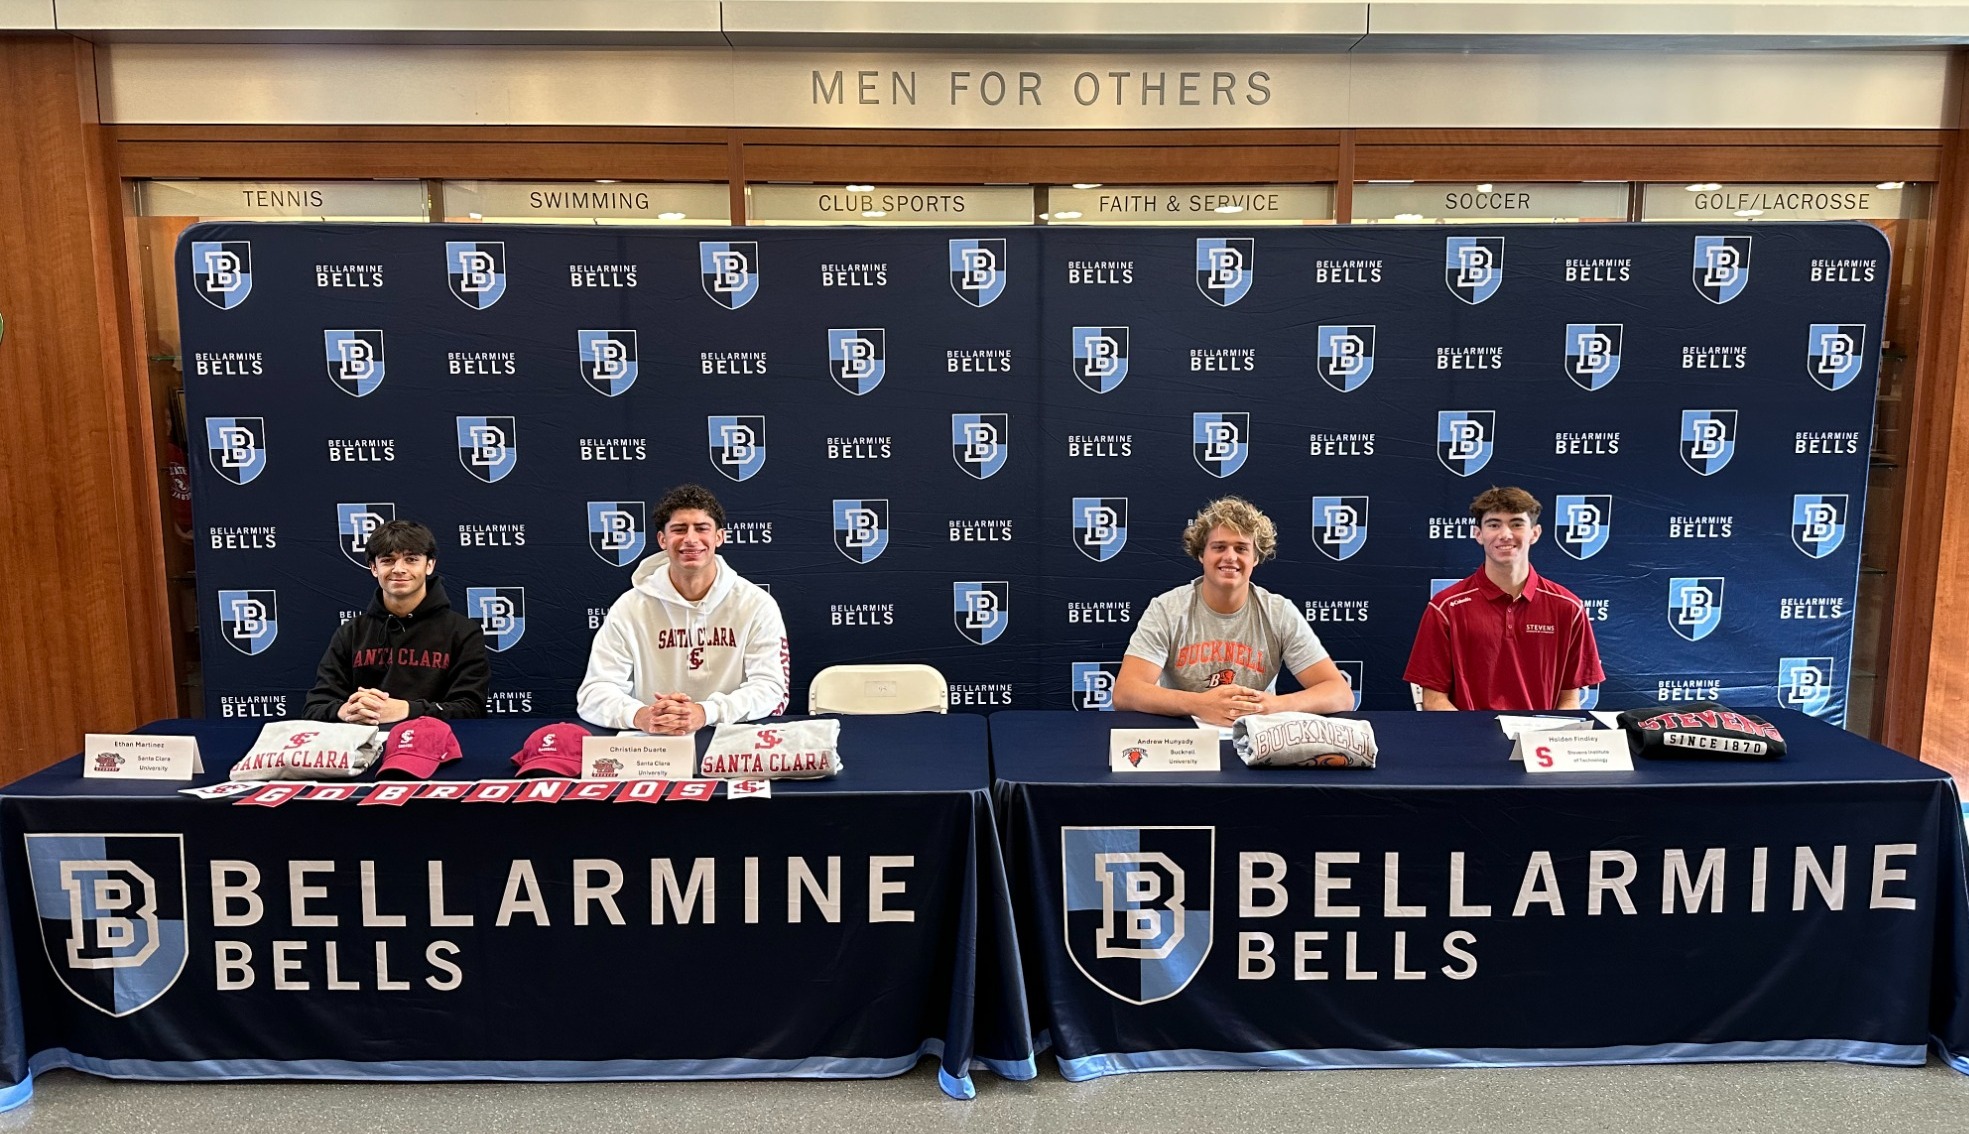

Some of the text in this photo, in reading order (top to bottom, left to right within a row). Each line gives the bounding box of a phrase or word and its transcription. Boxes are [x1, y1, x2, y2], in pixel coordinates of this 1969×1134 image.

[813, 70, 1271, 106] MEN FOR OTHERS
[242, 190, 323, 208] TENNIS
[530, 191, 649, 210] SWIMMING
[818, 194, 965, 213] CLUB SPORTS
[1099, 194, 1279, 213] FAITH & SERVICE
[1445, 192, 1530, 210] SOCCER
[1694, 193, 1870, 211] GOLF/LACROSSE
[315, 264, 383, 273] BELLARMINE
[569, 264, 637, 273] BELLARMINE
[821, 263, 888, 272] BELLARMINE
[961, 248, 996, 290] B
[1068, 261, 1134, 270] BELLARMINE
[1207, 247, 1243, 290] B
[1316, 260, 1383, 269] BELLARMINE
[1457, 245, 1493, 288] B
[1565, 258, 1631, 267] BELLARMINE
[1703, 245, 1740, 287] B
[1811, 259, 1877, 268] BELLARMINE
[204, 251, 242, 292] B
[458, 250, 496, 294] B
[712, 250, 749, 293] B
[1069, 270, 1133, 284] BELLS
[1316, 268, 1382, 283] BELLS
[1565, 267, 1630, 282] BELLS
[1810, 268, 1875, 282] BELLS
[316, 273, 384, 288] BELLS
[570, 273, 638, 288] BELLS
[822, 272, 887, 287] BELLS
[195, 352, 263, 361] BELLARMINE
[448, 352, 515, 361] BELLARMINE
[700, 352, 767, 360] BELLARMINE
[946, 349, 1012, 358] BELLARMINE
[1190, 348, 1255, 357] BELLARMINE
[1437, 346, 1503, 355] BELLARMINE
[1682, 346, 1747, 355] BELLARMINE
[1818, 333, 1854, 374] B
[840, 337, 876, 379] B
[1190, 357, 1255, 371] BELLS
[1437, 355, 1502, 370] BELLS
[1682, 355, 1746, 369] BELLS
[196, 361, 263, 376] BELLS
[449, 361, 516, 375] BELLS
[701, 360, 767, 375] BELLS
[947, 358, 1011, 373] BELLS
[579, 438, 647, 447] BELLARMINE
[827, 436, 892, 445] BELLARMINE
[1068, 435, 1133, 443] BELLARMINE
[1204, 421, 1239, 462] B
[1310, 433, 1375, 442] BELLARMINE
[1555, 432, 1620, 441] BELLARMINE
[1795, 431, 1859, 440] BELLARMINE
[218, 426, 256, 468] B
[328, 439, 395, 448] BELLARMINE
[1069, 443, 1132, 457] BELLS
[1310, 442, 1374, 456] BELLS
[1555, 440, 1619, 455] BELLS
[1795, 440, 1857, 454] BELLS
[329, 447, 395, 462] BELLS
[580, 447, 647, 461] BELLS
[827, 445, 891, 459] BELLS
[725, 522, 772, 530] LLARMINE
[949, 519, 1012, 528] BELLARMINE
[1084, 506, 1118, 546] B
[1429, 517, 1476, 525] BELLARM
[1565, 503, 1601, 544] B
[1670, 516, 1733, 524] BELLARMINE
[210, 526, 276, 535] BELLARMINE
[458, 524, 525, 532] BELLARMINE
[599, 510, 636, 550] B
[949, 528, 1012, 542] BELLS
[1429, 525, 1477, 539] BELL
[1669, 524, 1732, 538] BELLS
[211, 535, 277, 549] BELLS
[460, 532, 526, 547] BELLS
[724, 530, 772, 544] ELLS
[830, 604, 894, 612] BELLARMINE
[1068, 601, 1131, 610] BELLARMINE
[1304, 600, 1369, 608] BELLARMINE
[1678, 586, 1713, 625] B
[1780, 597, 1844, 606] BELLARMINE
[965, 590, 999, 629] B
[1068, 609, 1130, 623] BELLS
[1306, 609, 1368, 622] BELLS
[1779, 606, 1842, 620] BELLS
[231, 599, 268, 639] B
[831, 612, 894, 626] BELLS
[658, 628, 693, 649] SATA
[353, 648, 393, 668] ANTA
[1174, 639, 1266, 674] BUCKNELL
[950, 684, 1013, 692] BELLARMINE
[1658, 679, 1721, 688] BELLARMINE
[1787, 665, 1824, 704] B
[221, 695, 287, 704] BELLARMINE
[950, 692, 1012, 705] BELLS
[1657, 688, 1720, 701] BELLS
[222, 703, 287, 718] BELLS
[486, 699, 533, 713] ELLS
[135, 741, 165, 749] Martinez
[1255, 719, 1375, 764] BUCKNELL
[1669, 734, 1762, 754] SINCE 1870
[291, 750, 349, 769] CLARA
[702, 751, 831, 774] SANTA CLARA
[1535, 746, 1554, 768] S
[374, 781, 705, 800] BRONCOS
[1238, 843, 1917, 918] BELLARMINE
[209, 855, 915, 927] BELLARMINE
[1095, 852, 1187, 960] B
[60, 859, 159, 970] B
[1238, 930, 1478, 981] BELLS
[214, 940, 463, 991] BELLS
